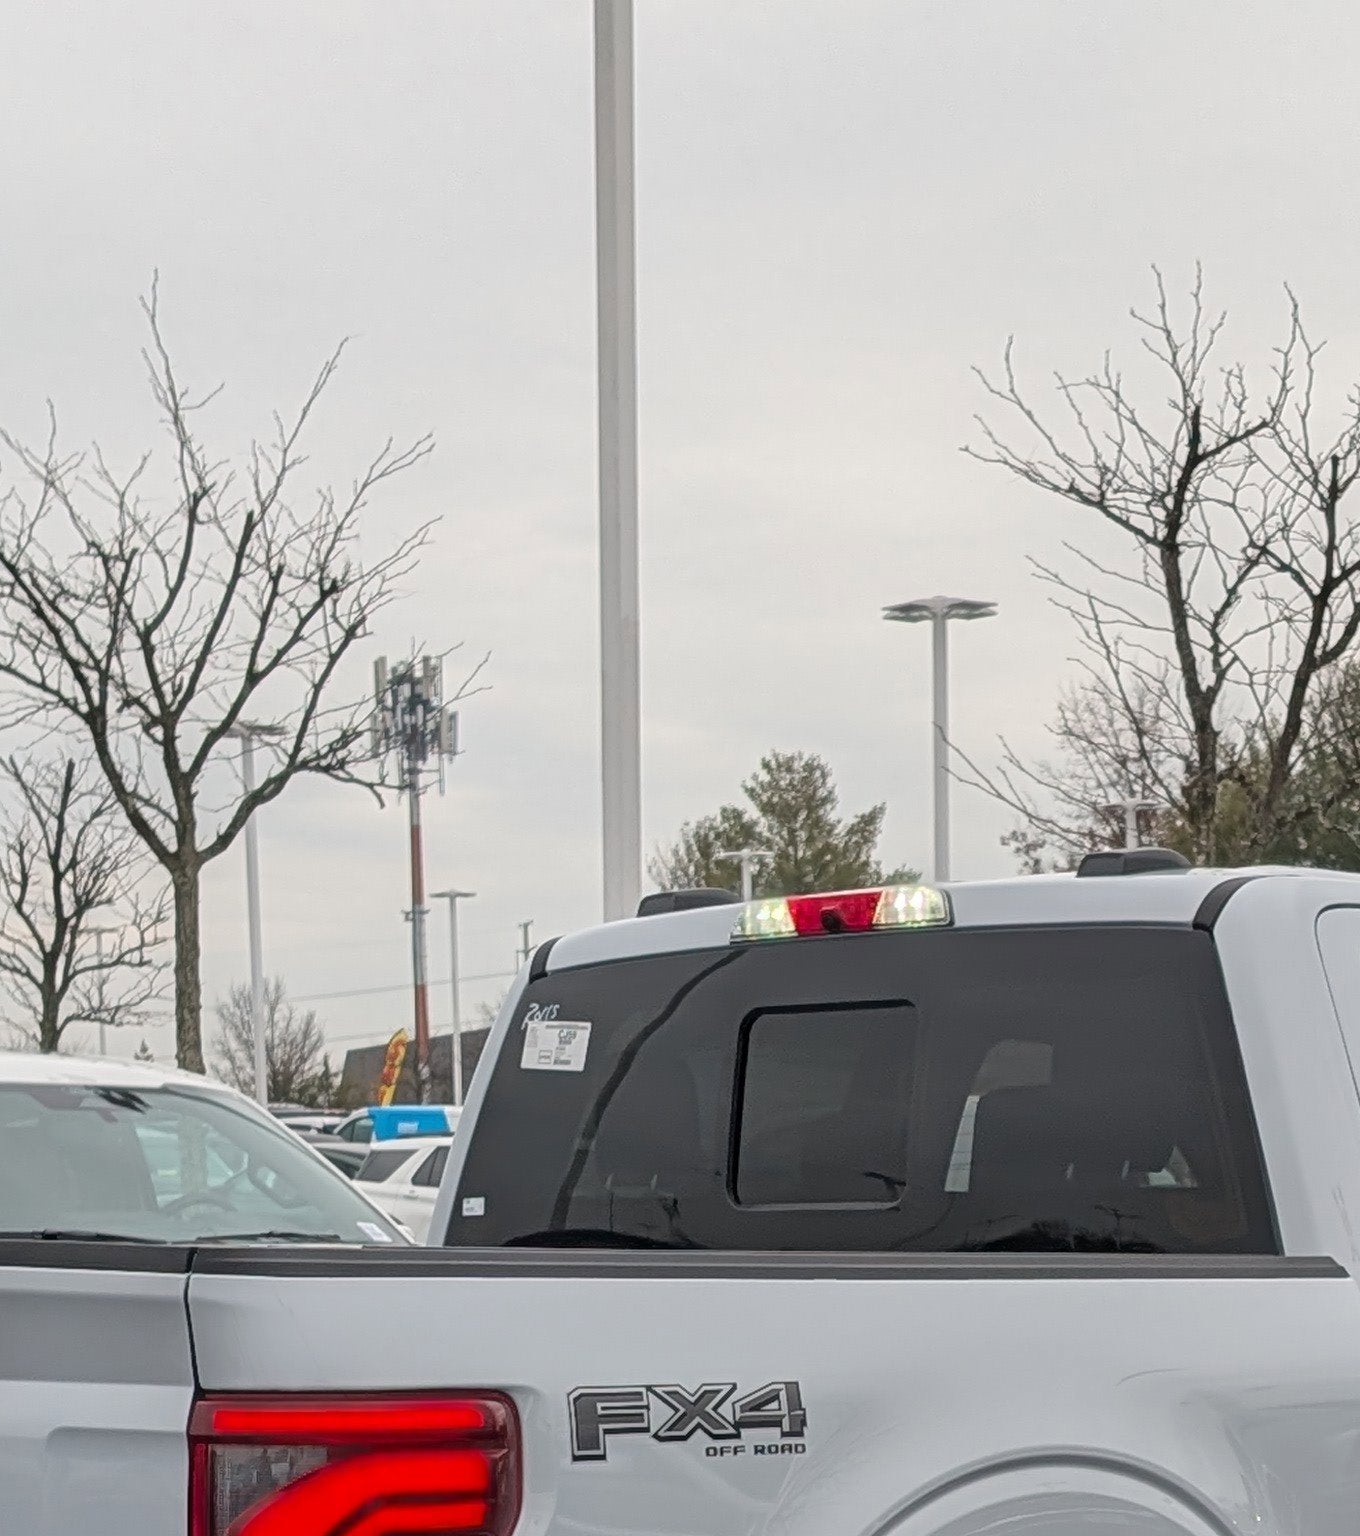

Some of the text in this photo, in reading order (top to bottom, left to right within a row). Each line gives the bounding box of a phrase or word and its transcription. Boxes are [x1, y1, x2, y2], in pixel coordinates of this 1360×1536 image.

[567, 1381, 807, 1462] FX4
[705, 1443, 807, 1457] OFF ROAD
